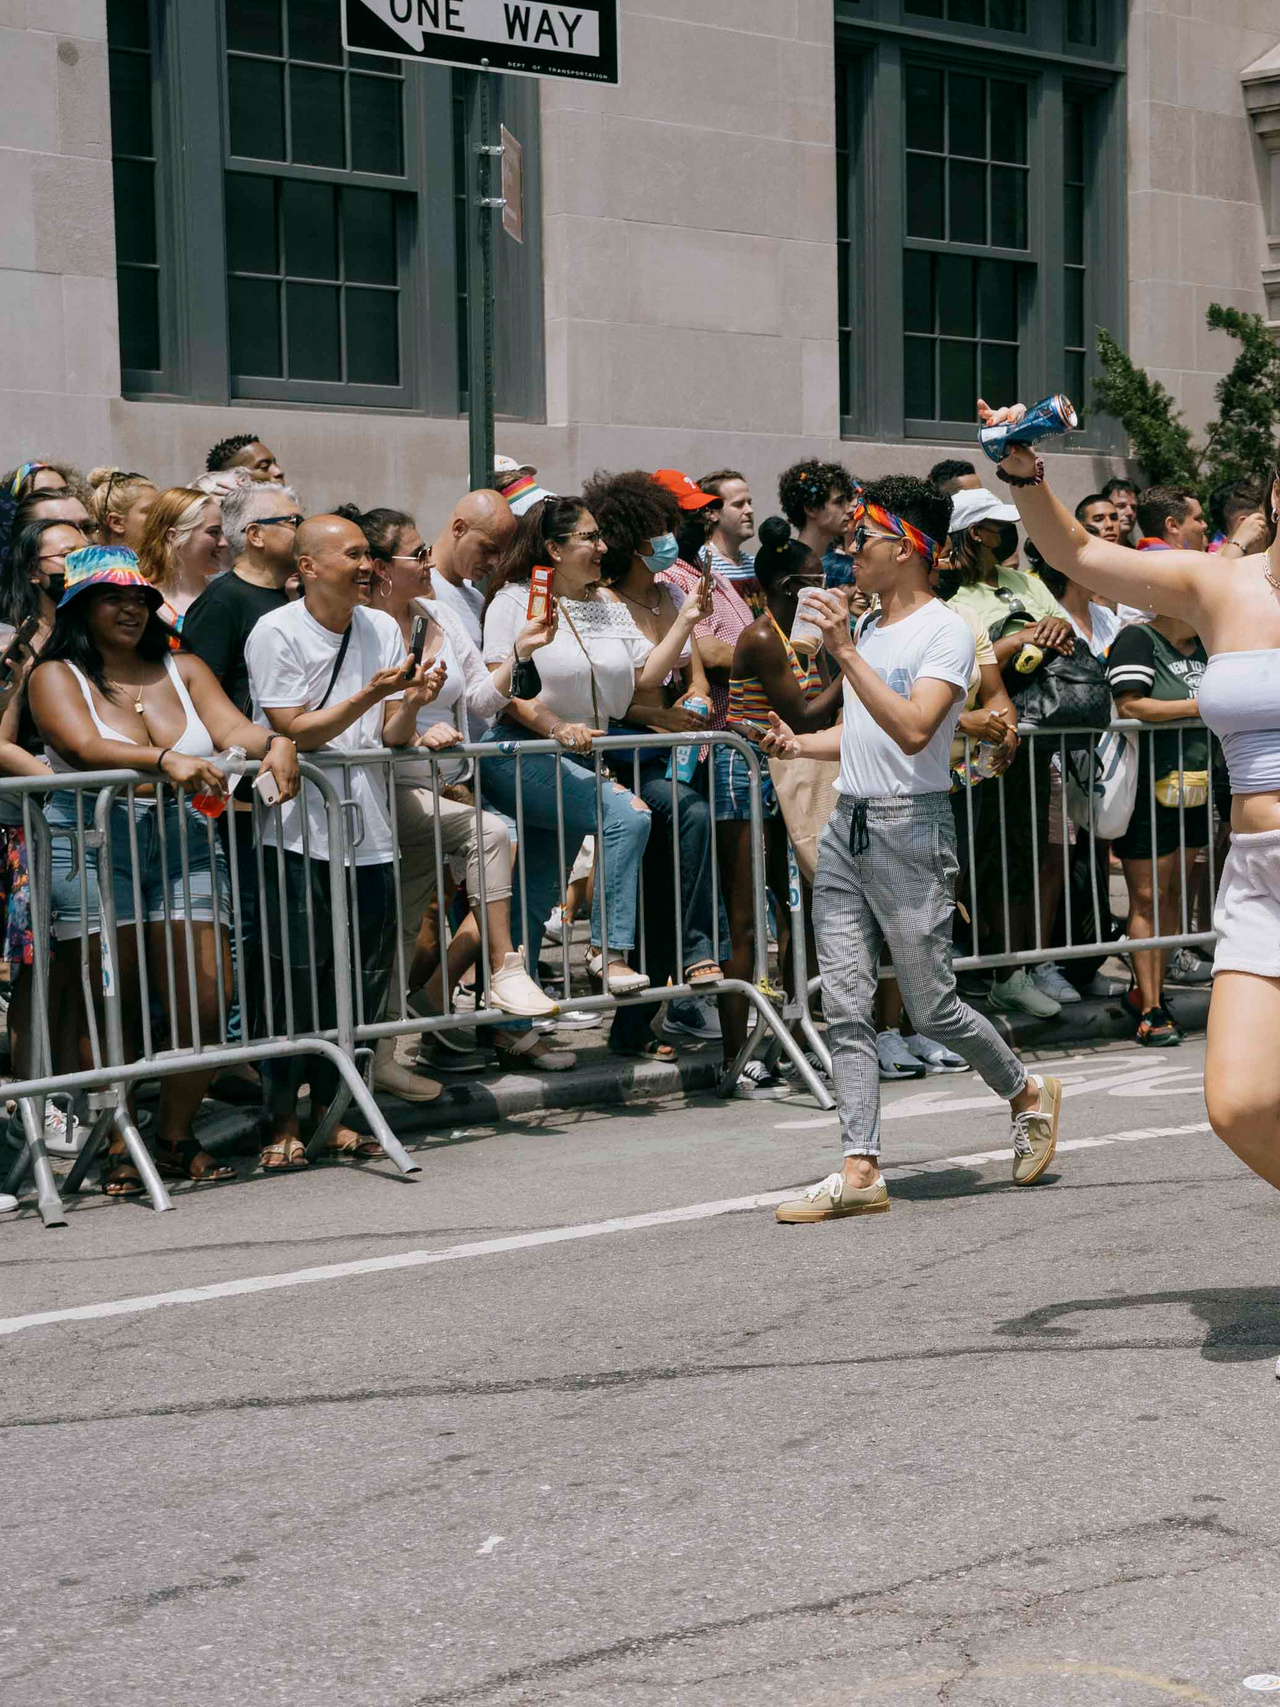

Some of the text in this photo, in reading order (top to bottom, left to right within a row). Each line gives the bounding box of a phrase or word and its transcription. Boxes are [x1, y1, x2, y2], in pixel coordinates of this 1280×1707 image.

[390, 0, 583, 48] ONE WAY
[507, 61, 526, 69] DEPT
[548, 67, 608, 79] TRANSPORTATION
